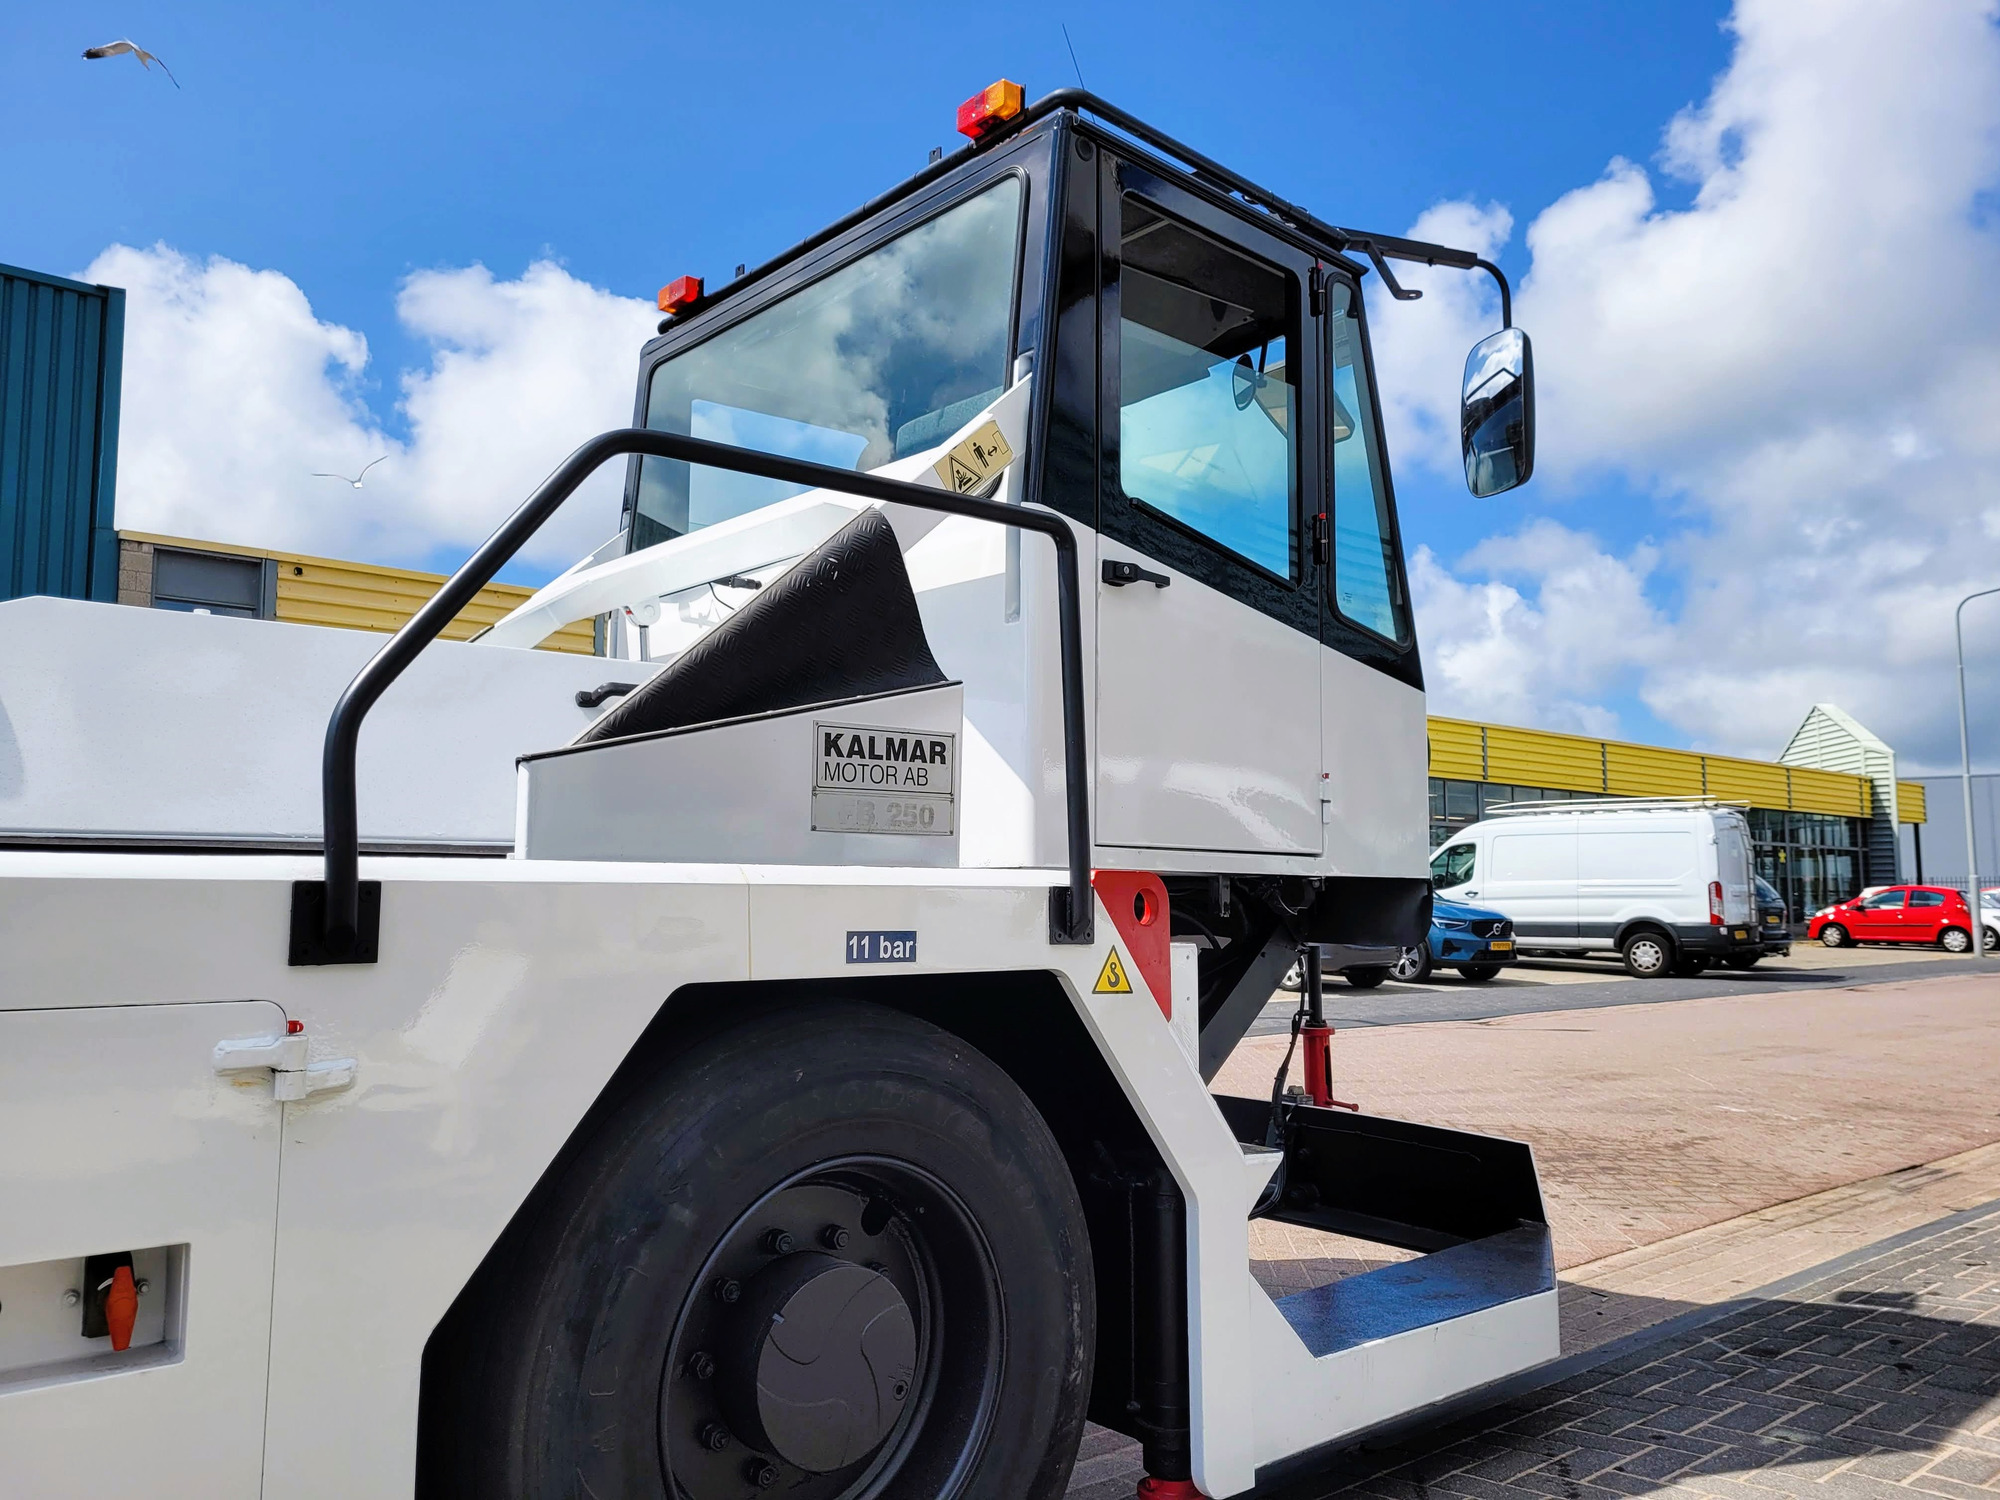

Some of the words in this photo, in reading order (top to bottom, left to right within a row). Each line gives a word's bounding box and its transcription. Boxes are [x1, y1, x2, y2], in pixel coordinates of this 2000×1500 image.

[824, 732, 947, 765] KALMAR
[824, 761, 898, 785] MOTOR
[903, 767, 929, 786] AB
[886, 802, 935, 829] 250
[848, 935, 870, 959] 11
[879, 935, 914, 959] bar
